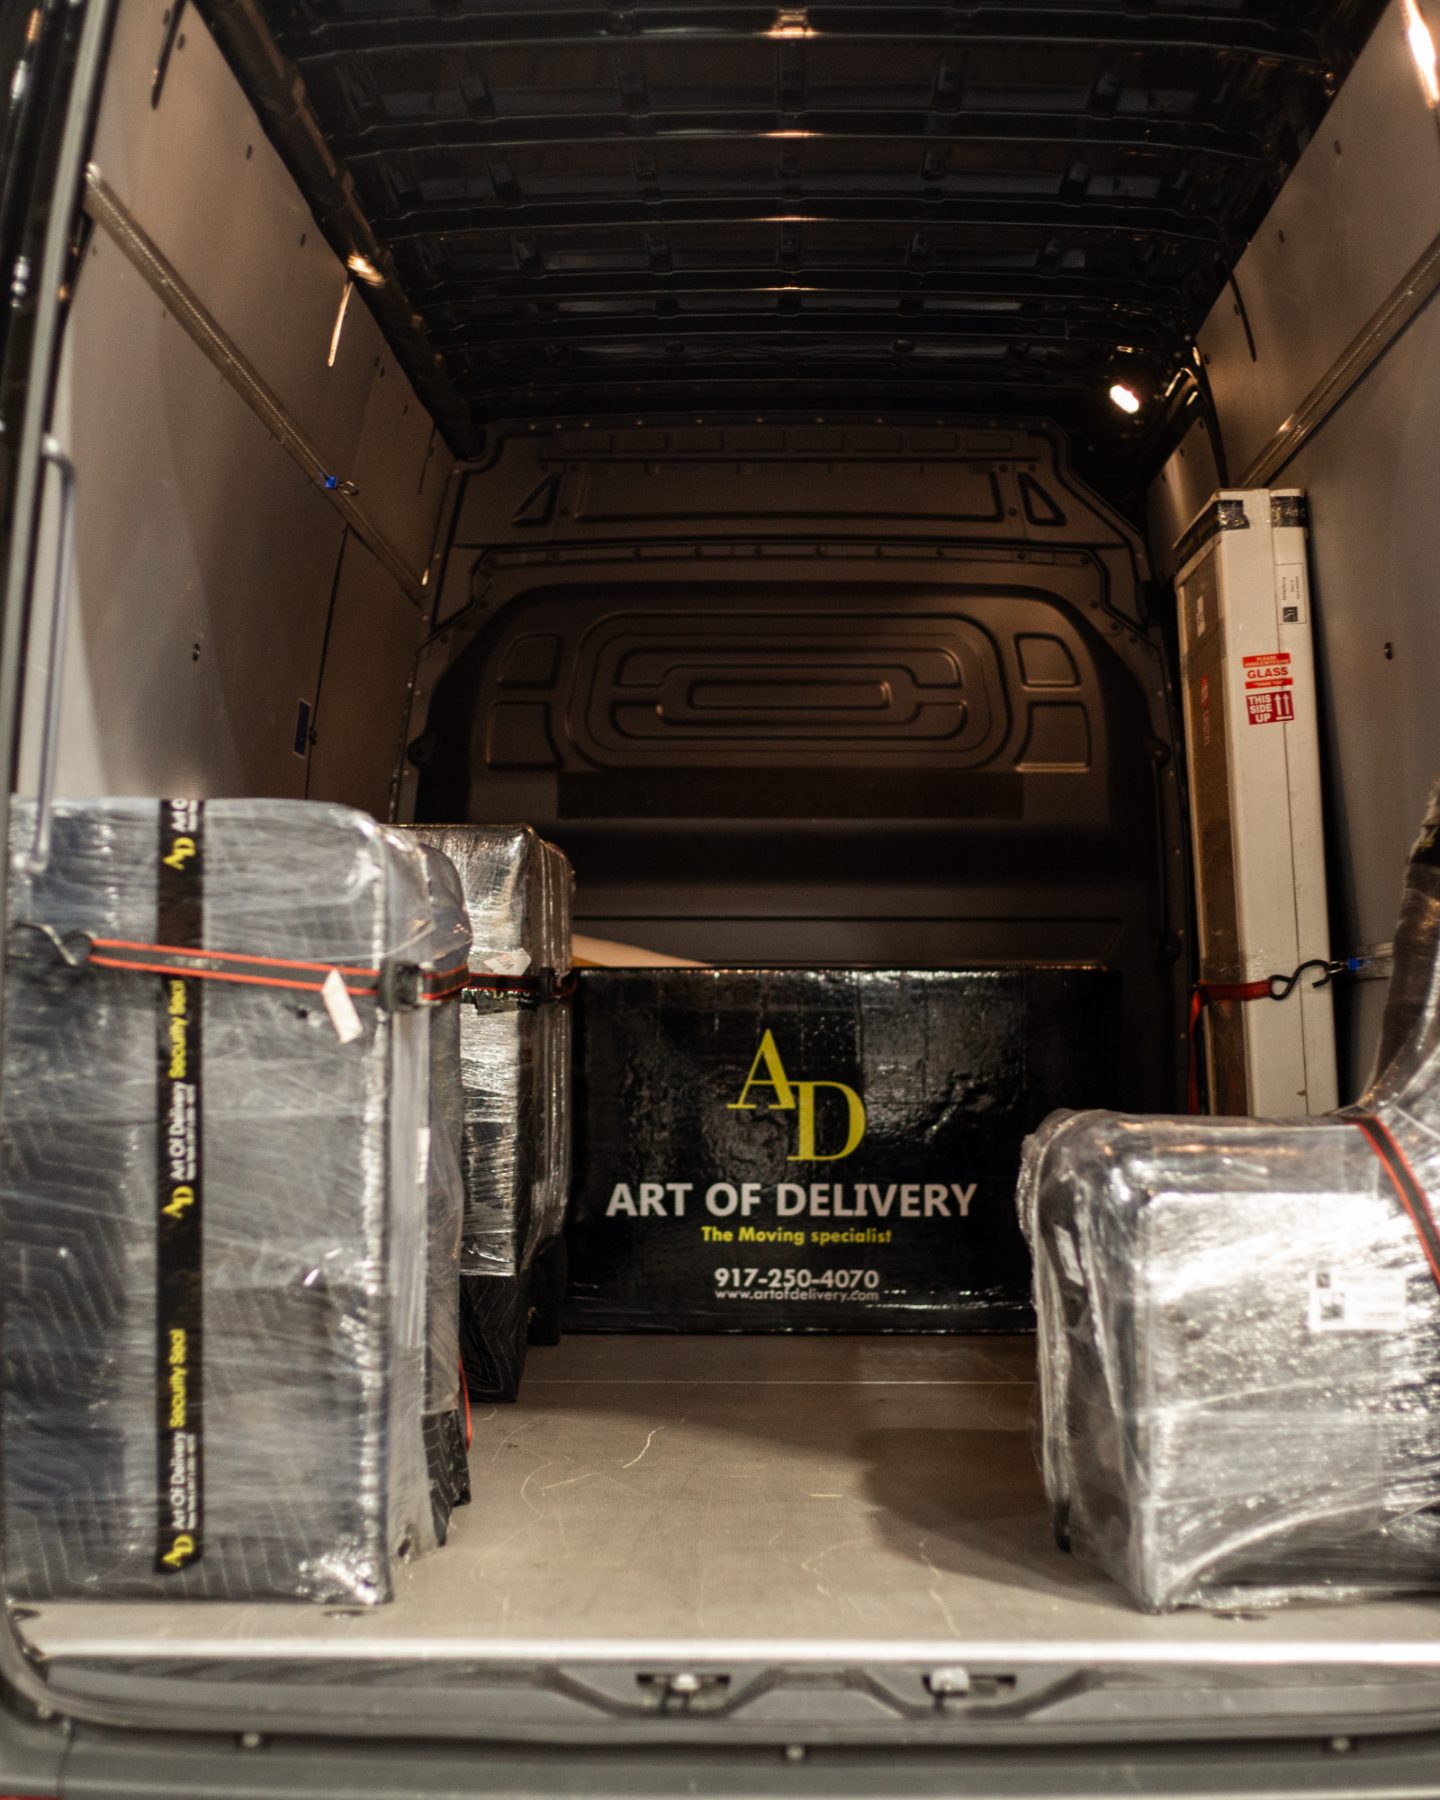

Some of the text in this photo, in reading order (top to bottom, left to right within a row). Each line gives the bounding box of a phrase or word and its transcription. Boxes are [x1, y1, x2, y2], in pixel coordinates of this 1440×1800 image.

[1247, 666, 1289, 679] GLASS
[1247, 694, 1272, 705] THIS
[1249, 703, 1273, 714] SIDE
[1254, 713, 1271, 723] UP
[169, 1016, 188, 1078] Security
[169, 1081, 187, 1136] Delivery
[605, 1182, 977, 1217] ART OF DELIVERY
[701, 1226, 892, 1246] The Moving specialist
[714, 1268, 879, 1288] 917-250-4070
[715, 1286, 879, 1302] www.artofdelivery.com
[169, 1328, 186, 1364] Seal
[170, 1367, 188, 1428] Security
[170, 1431, 187, 1485] Delivery
[172, 1509, 186, 1530] Art
